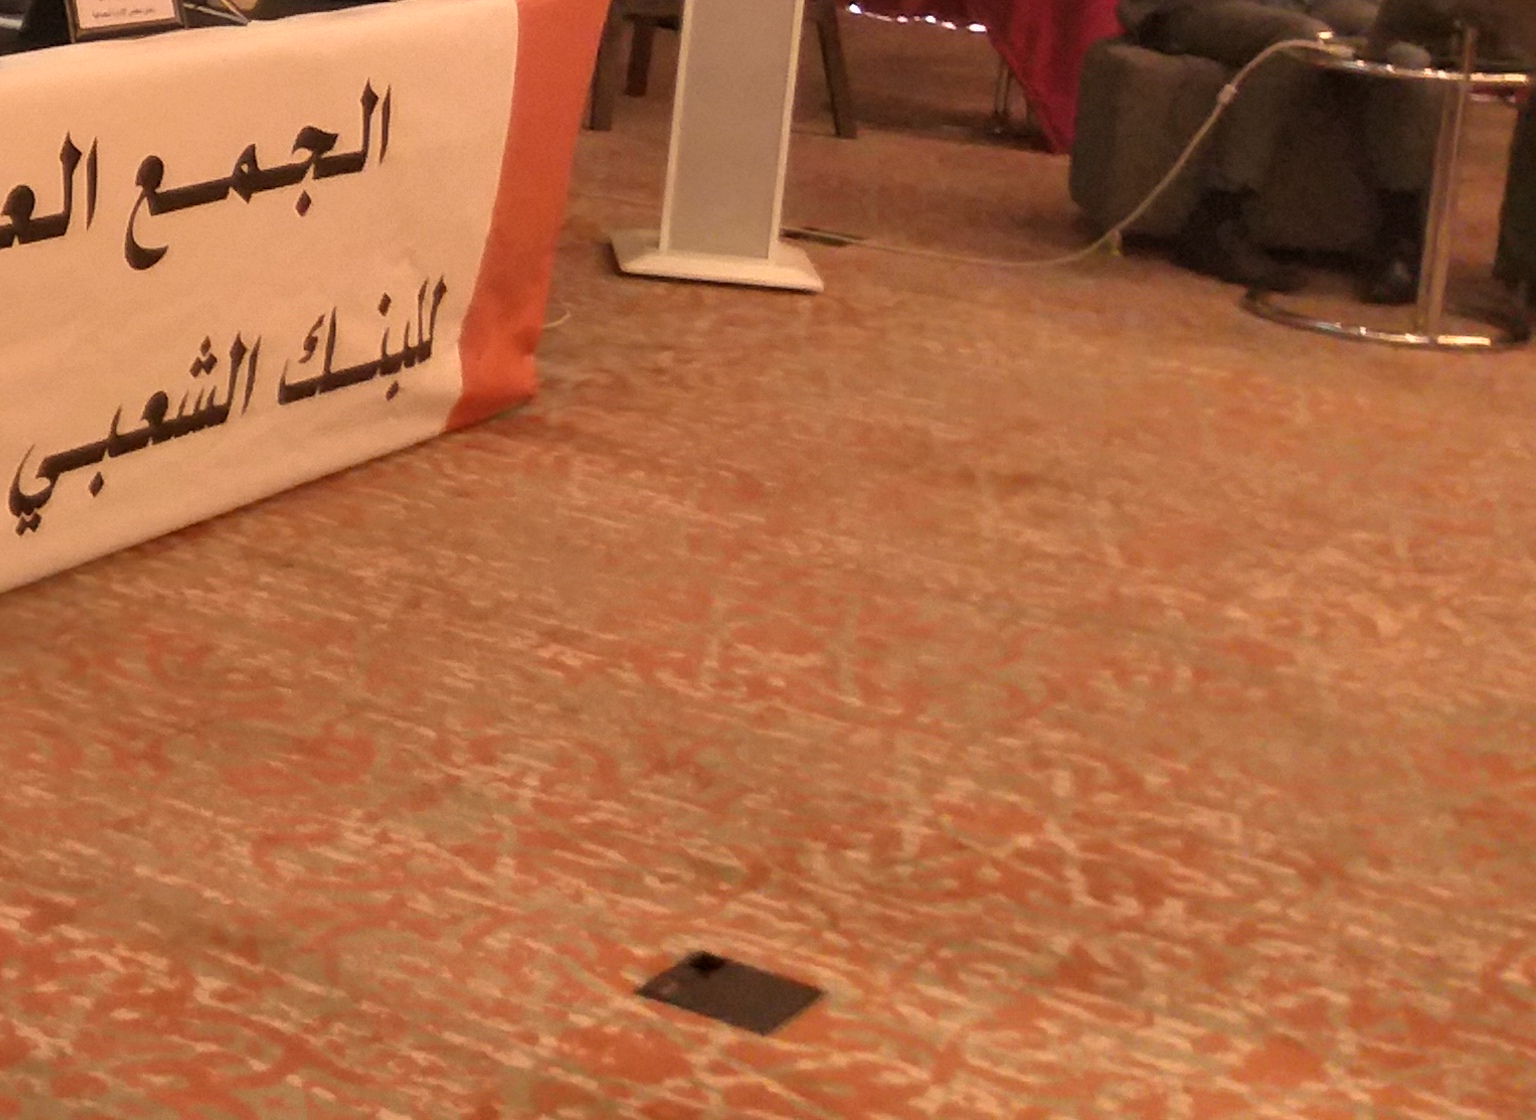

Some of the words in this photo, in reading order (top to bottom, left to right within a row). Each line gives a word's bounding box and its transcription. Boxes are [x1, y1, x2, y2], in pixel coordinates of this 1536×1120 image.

[125, 80, 392, 271] الجمع
[276, 276, 449, 402] للبنك
[8, 332, 262, 538] الشعبي
